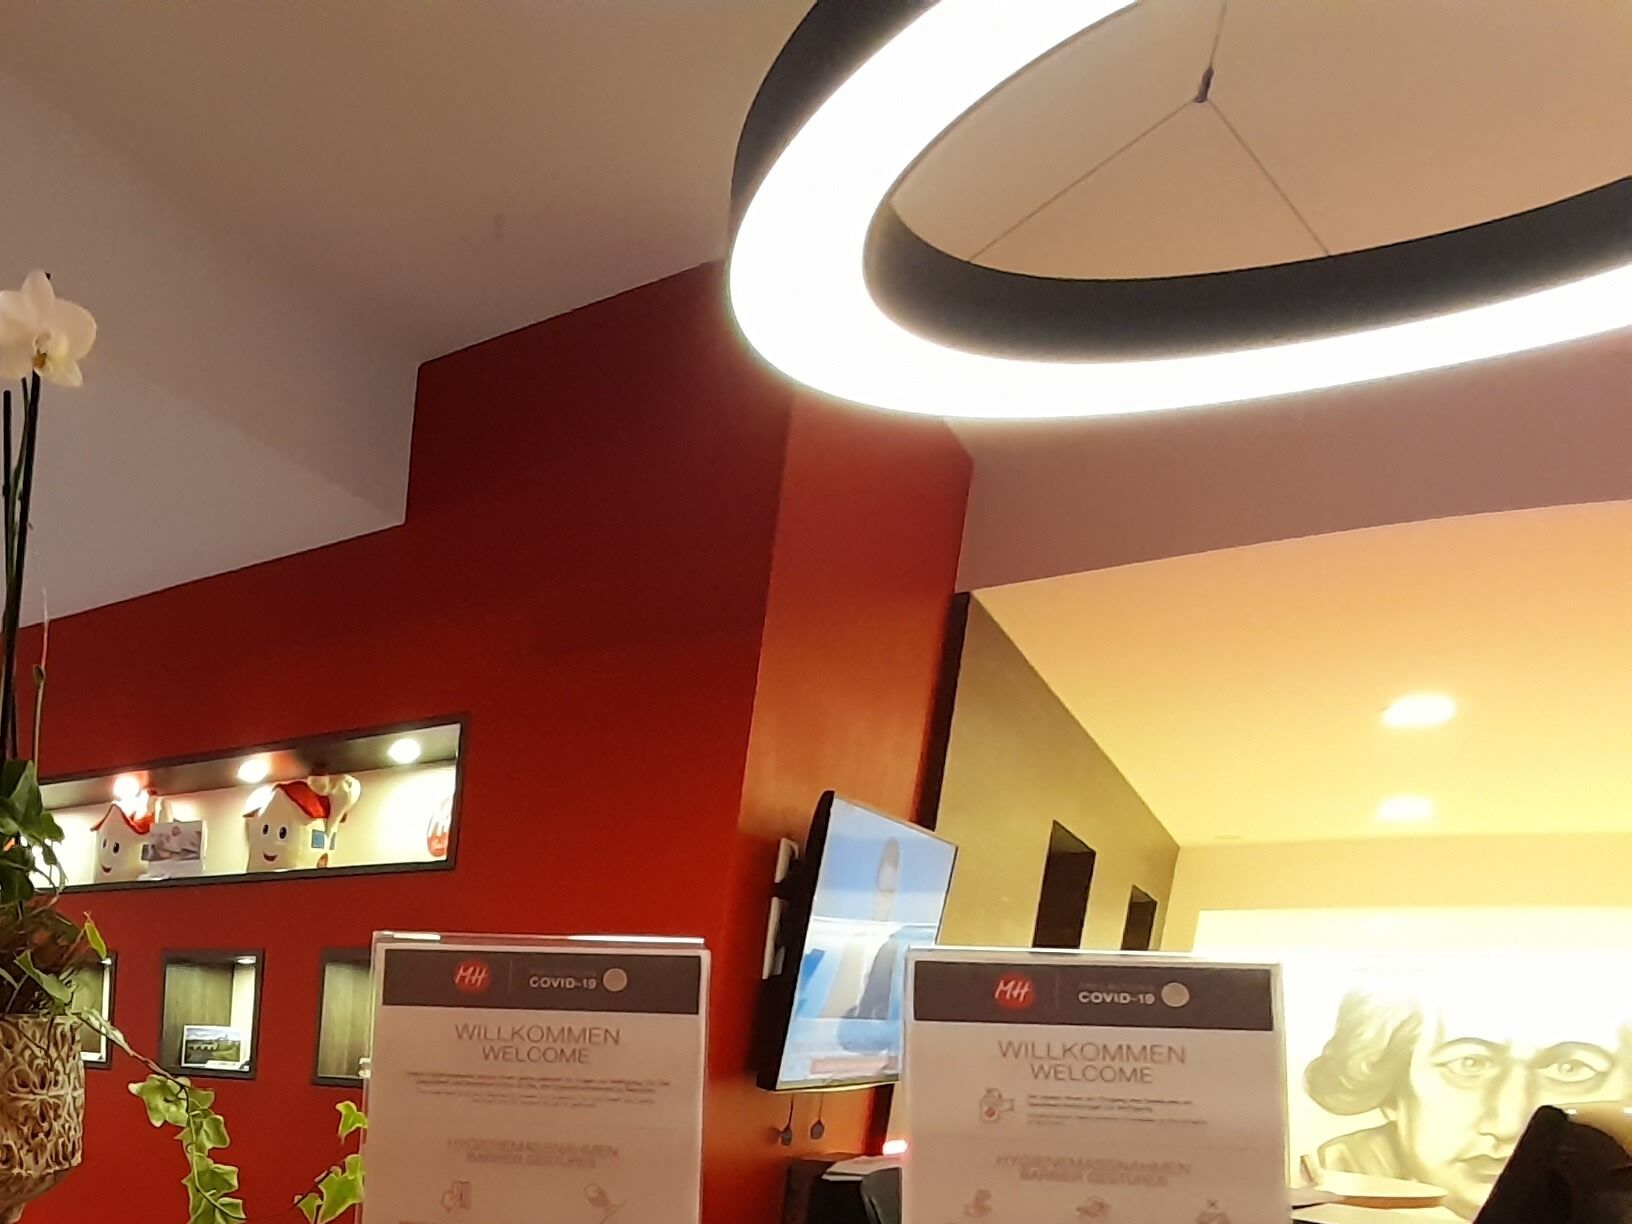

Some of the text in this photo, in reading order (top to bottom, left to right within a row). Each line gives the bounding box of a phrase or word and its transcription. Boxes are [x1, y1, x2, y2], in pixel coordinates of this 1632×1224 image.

[529, 975, 597, 991] COVID-19
[995, 979, 1032, 1001] MH
[1078, 990, 1155, 1005] COVID-19
[455, 1023, 621, 1047] WILLKOMMEN
[482, 1044, 591, 1065] WELCOME
[997, 1039, 1187, 1065] WILLKOMMEN
[1030, 1063, 1154, 1085] WELCOME
